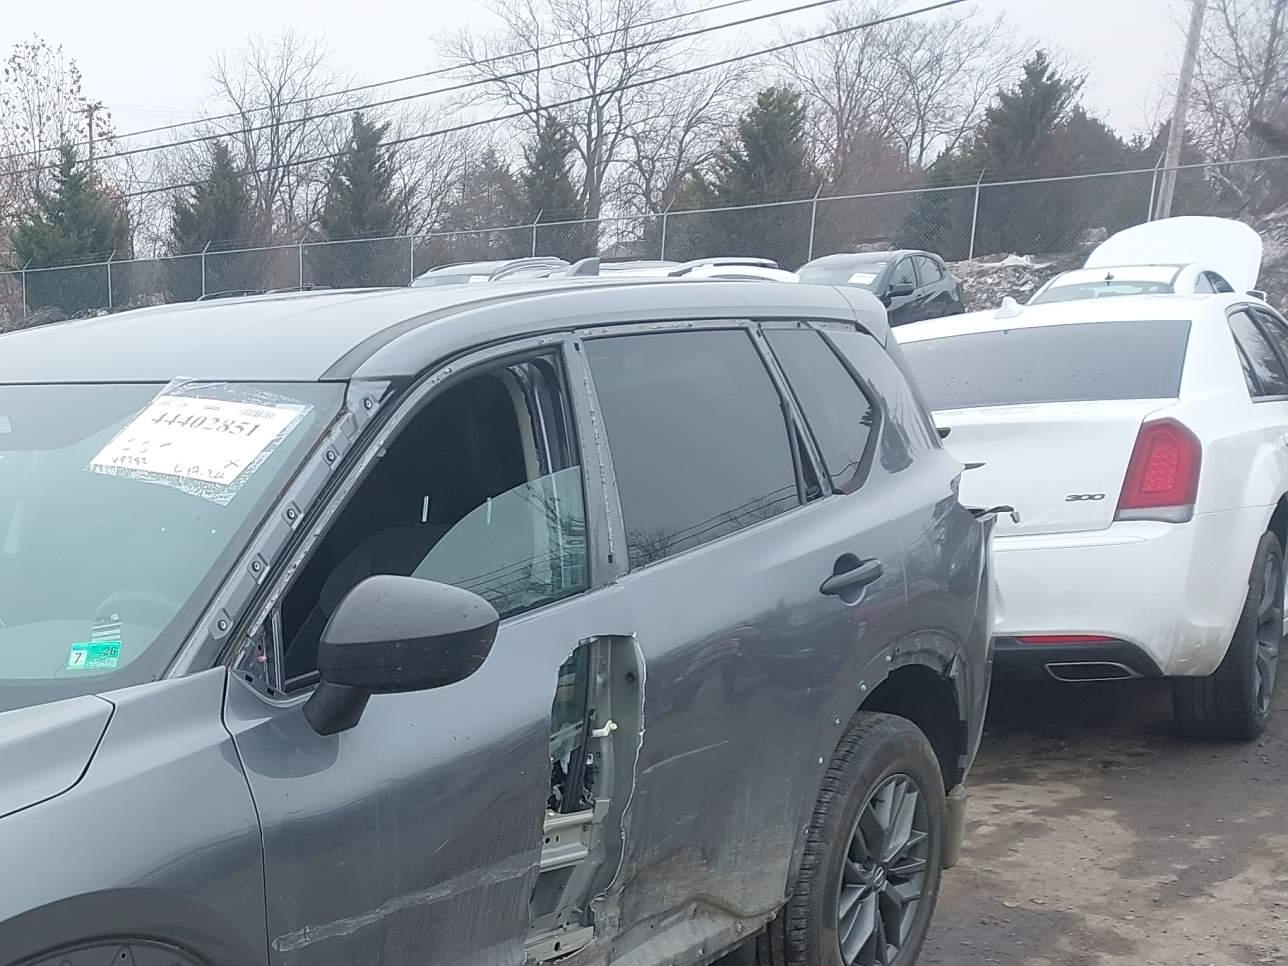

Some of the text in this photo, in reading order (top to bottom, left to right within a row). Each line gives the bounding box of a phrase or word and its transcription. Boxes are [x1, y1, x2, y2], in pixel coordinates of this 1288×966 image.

[151, 412, 261, 436] 44402851
[1064, 493, 1106, 502] 300
[73, 652, 82, 664] 7
